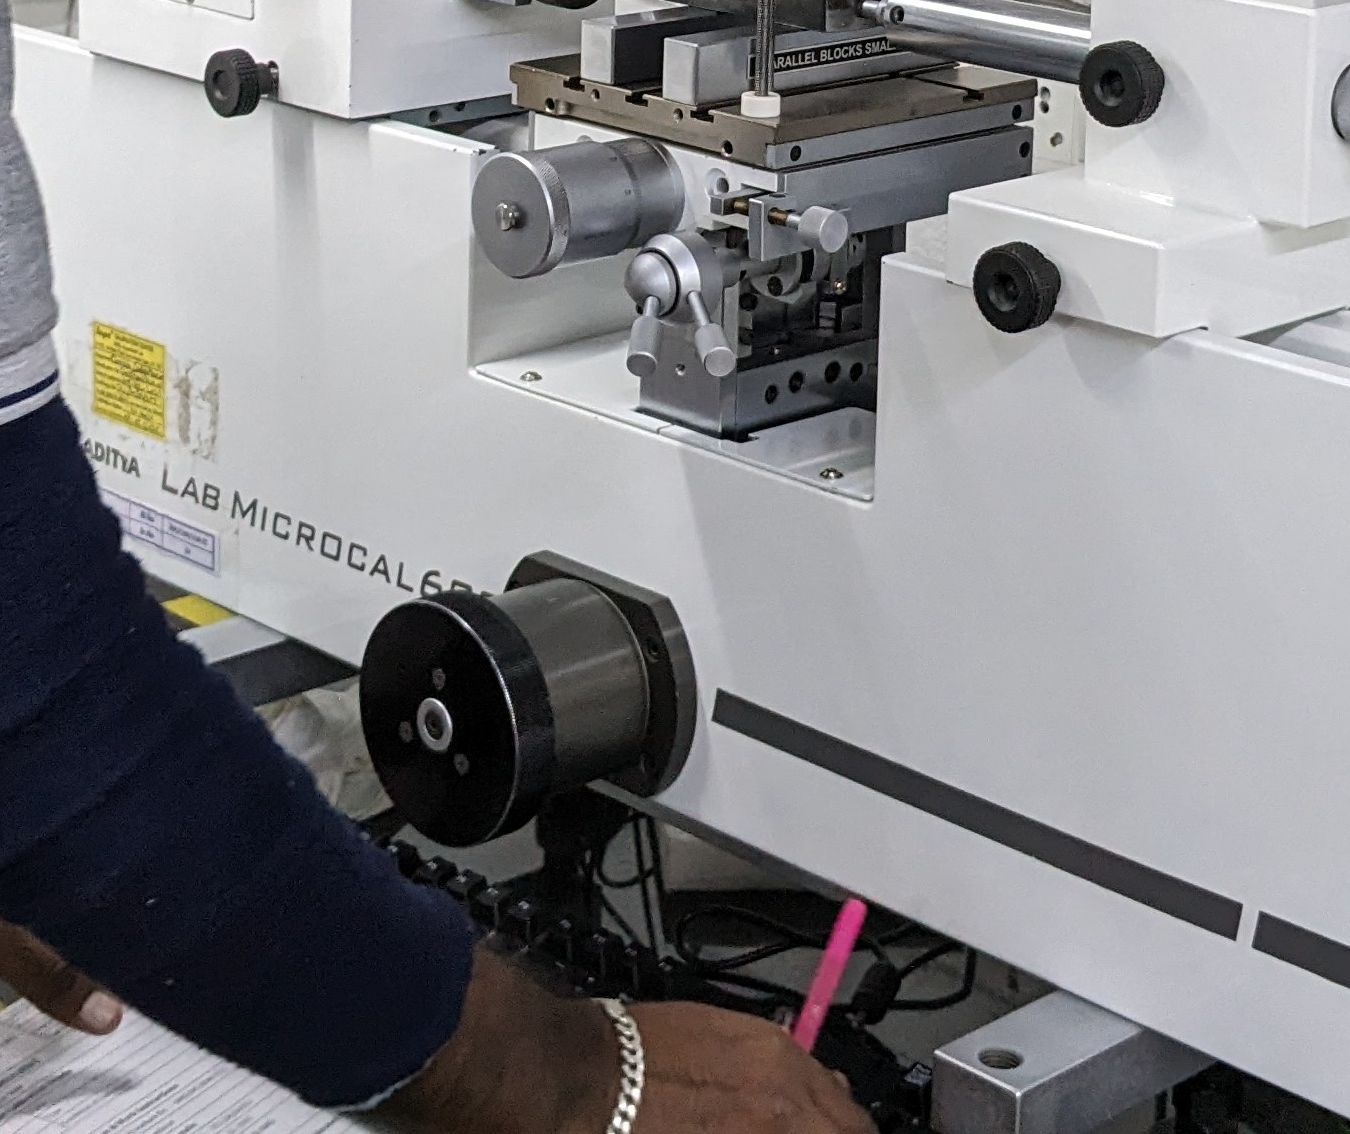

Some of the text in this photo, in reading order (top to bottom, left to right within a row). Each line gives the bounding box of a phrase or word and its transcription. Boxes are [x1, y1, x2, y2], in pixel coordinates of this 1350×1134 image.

[819, 44, 863, 63] BLOCKS
[864, 41, 897, 58] SMAL
[161, 460, 221, 511] LAB
